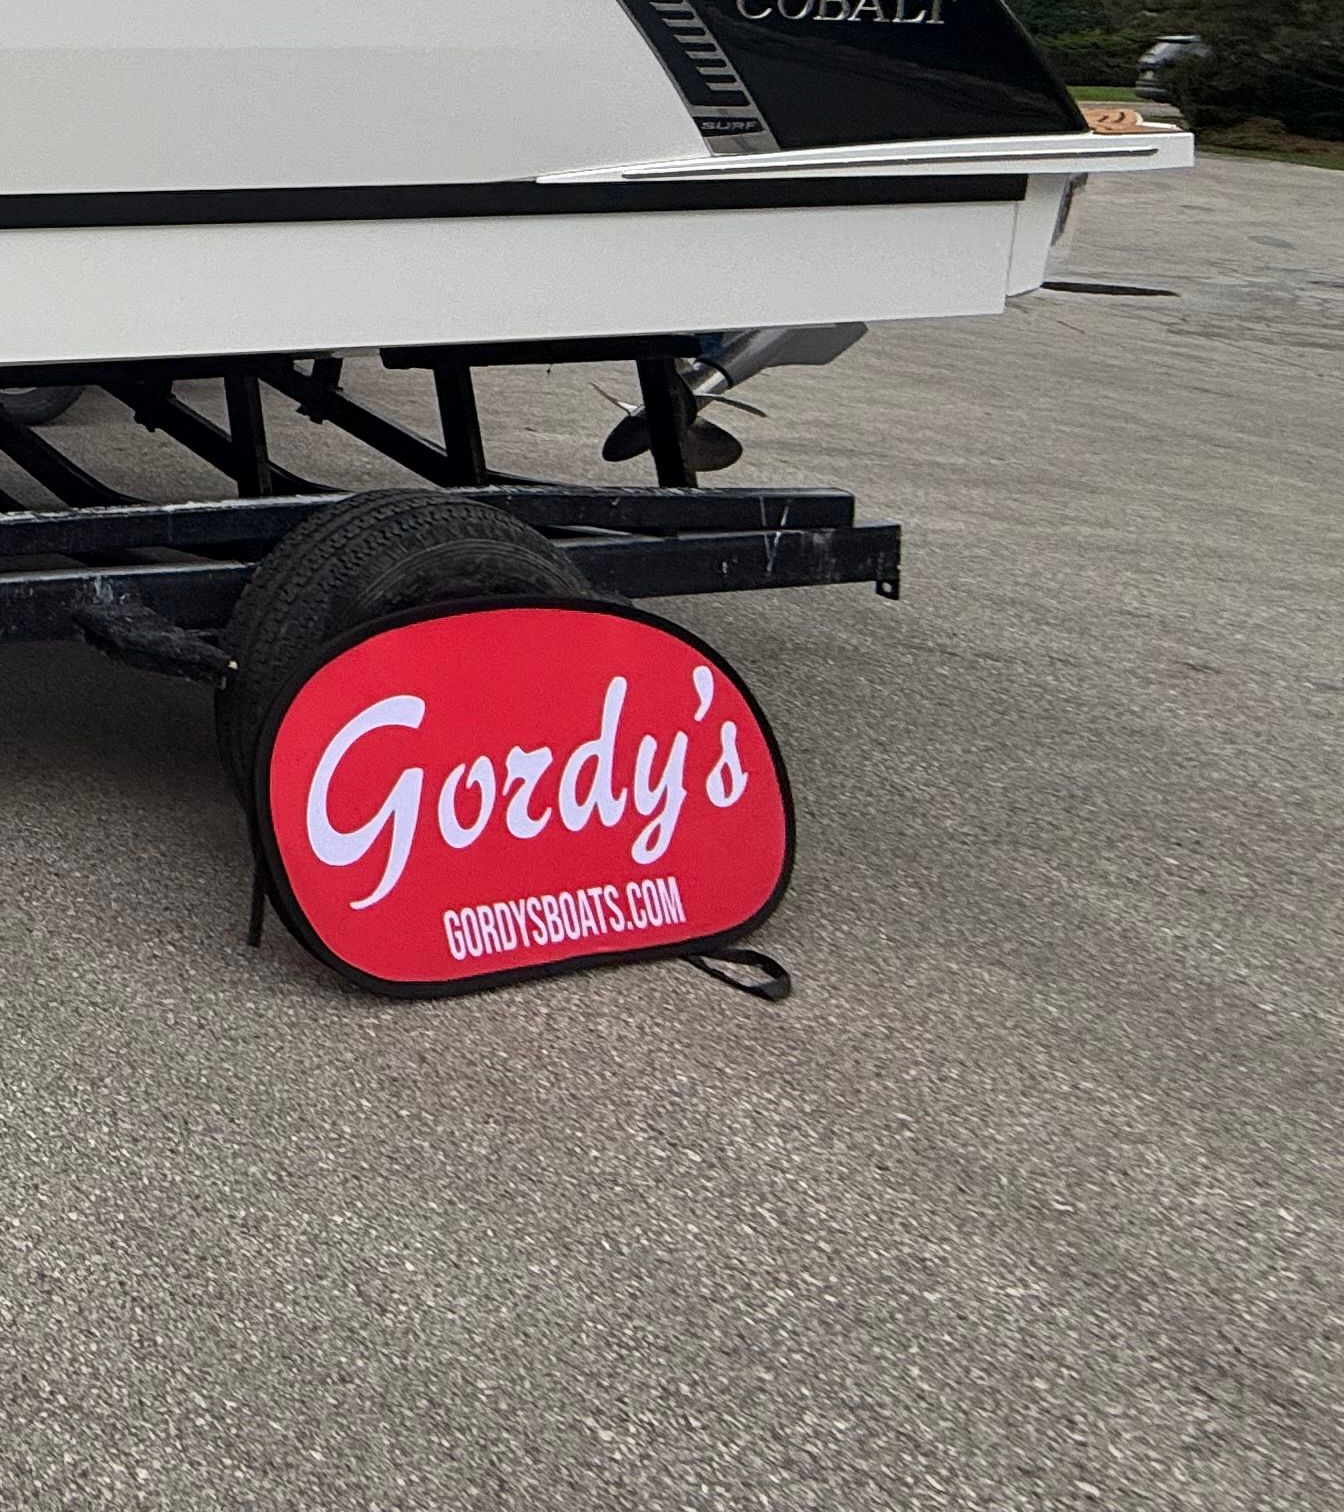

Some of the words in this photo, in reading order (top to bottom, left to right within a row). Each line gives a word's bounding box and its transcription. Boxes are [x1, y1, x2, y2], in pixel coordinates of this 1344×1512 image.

[700, 121, 758, 130] SURF
[306, 665, 749, 911] Gordy's
[443, 876, 686, 961] GORDYSBOATS.COM
